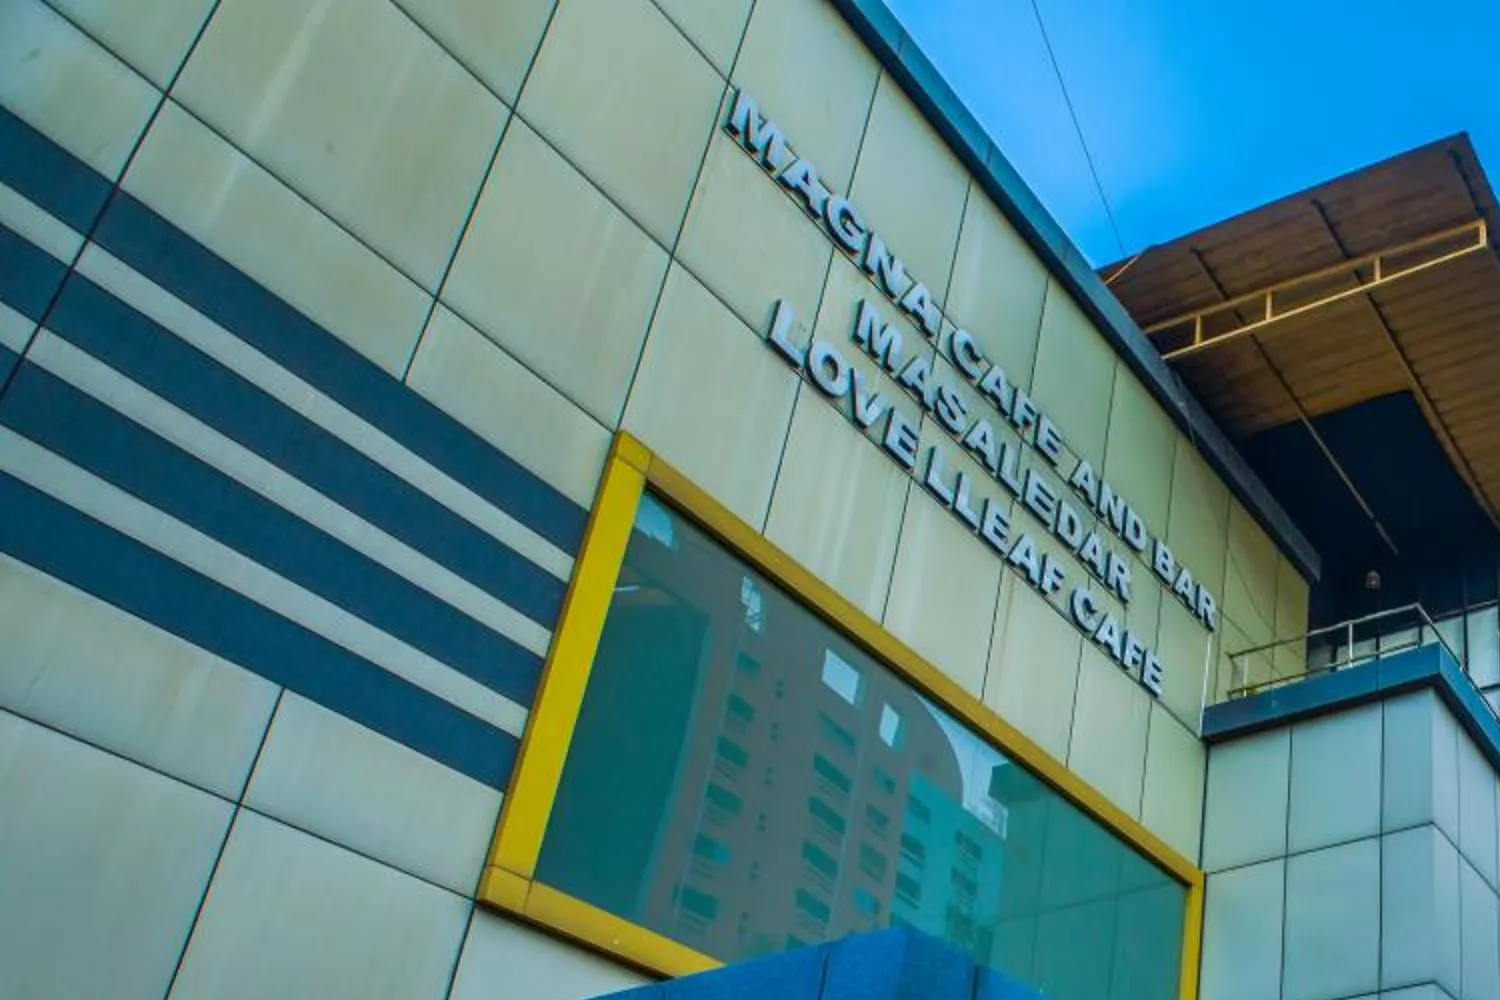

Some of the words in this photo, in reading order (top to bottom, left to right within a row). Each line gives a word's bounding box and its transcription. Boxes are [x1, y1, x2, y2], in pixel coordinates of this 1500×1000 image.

[727, 88, 941, 338] MAGNA
[950, 328, 1063, 467] CAFE
[1068, 458, 1148, 553] AND
[1152, 538, 1217, 633] BAR
[853, 299, 1133, 604] MASALEDAR
[1070, 585, 1165, 698] CAFE
